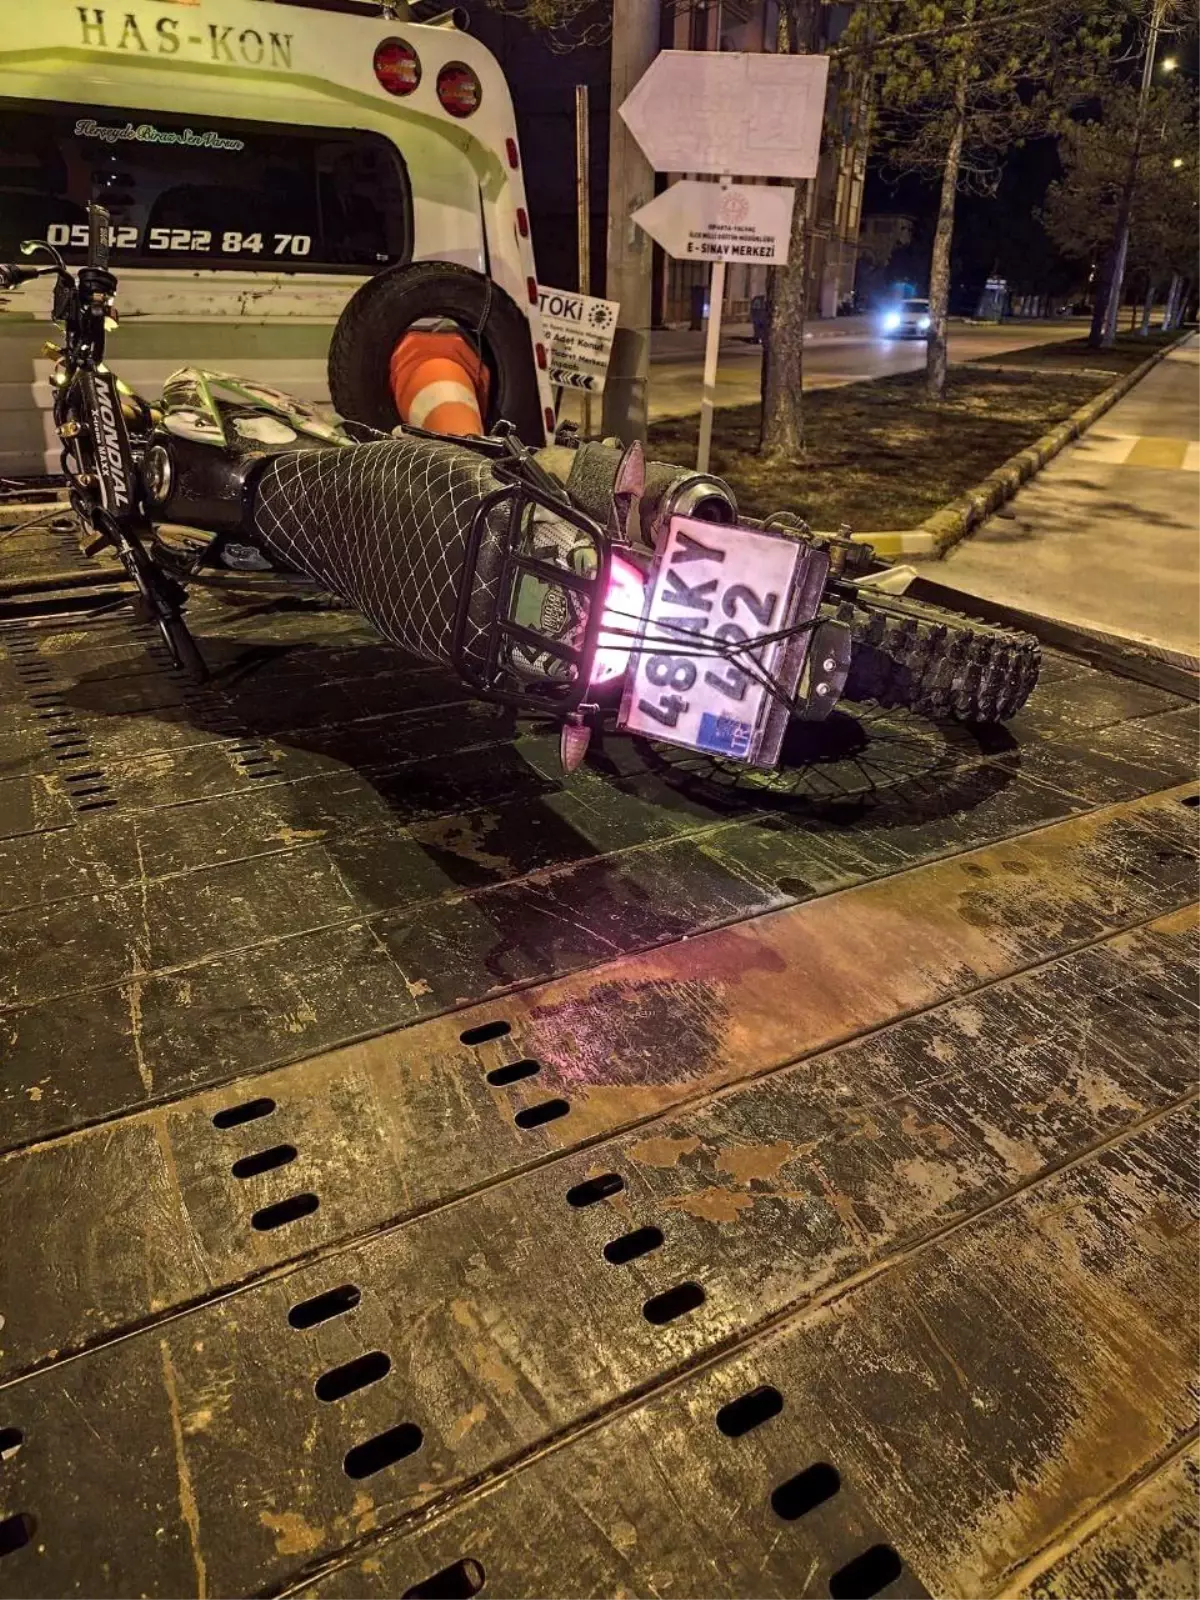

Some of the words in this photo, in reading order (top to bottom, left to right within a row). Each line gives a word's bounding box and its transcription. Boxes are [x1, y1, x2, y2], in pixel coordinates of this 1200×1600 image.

[77, 7, 294, 69] HAS-KON
[150, 228, 211, 251] 522
[222, 231, 264, 255] 84
[274, 233, 311, 256] 70
[701, 243, 730, 254] SINAV
[731, 245, 775, 257] MERKEZİ
[553, 334, 575, 345] Adet
[95, 377, 129, 507] MONDIAL
[98, 446, 110, 477] MAXX
[655, 531, 726, 644] AKY
[639, 655, 697, 728] 48
[731, 720, 750, 750] TR
